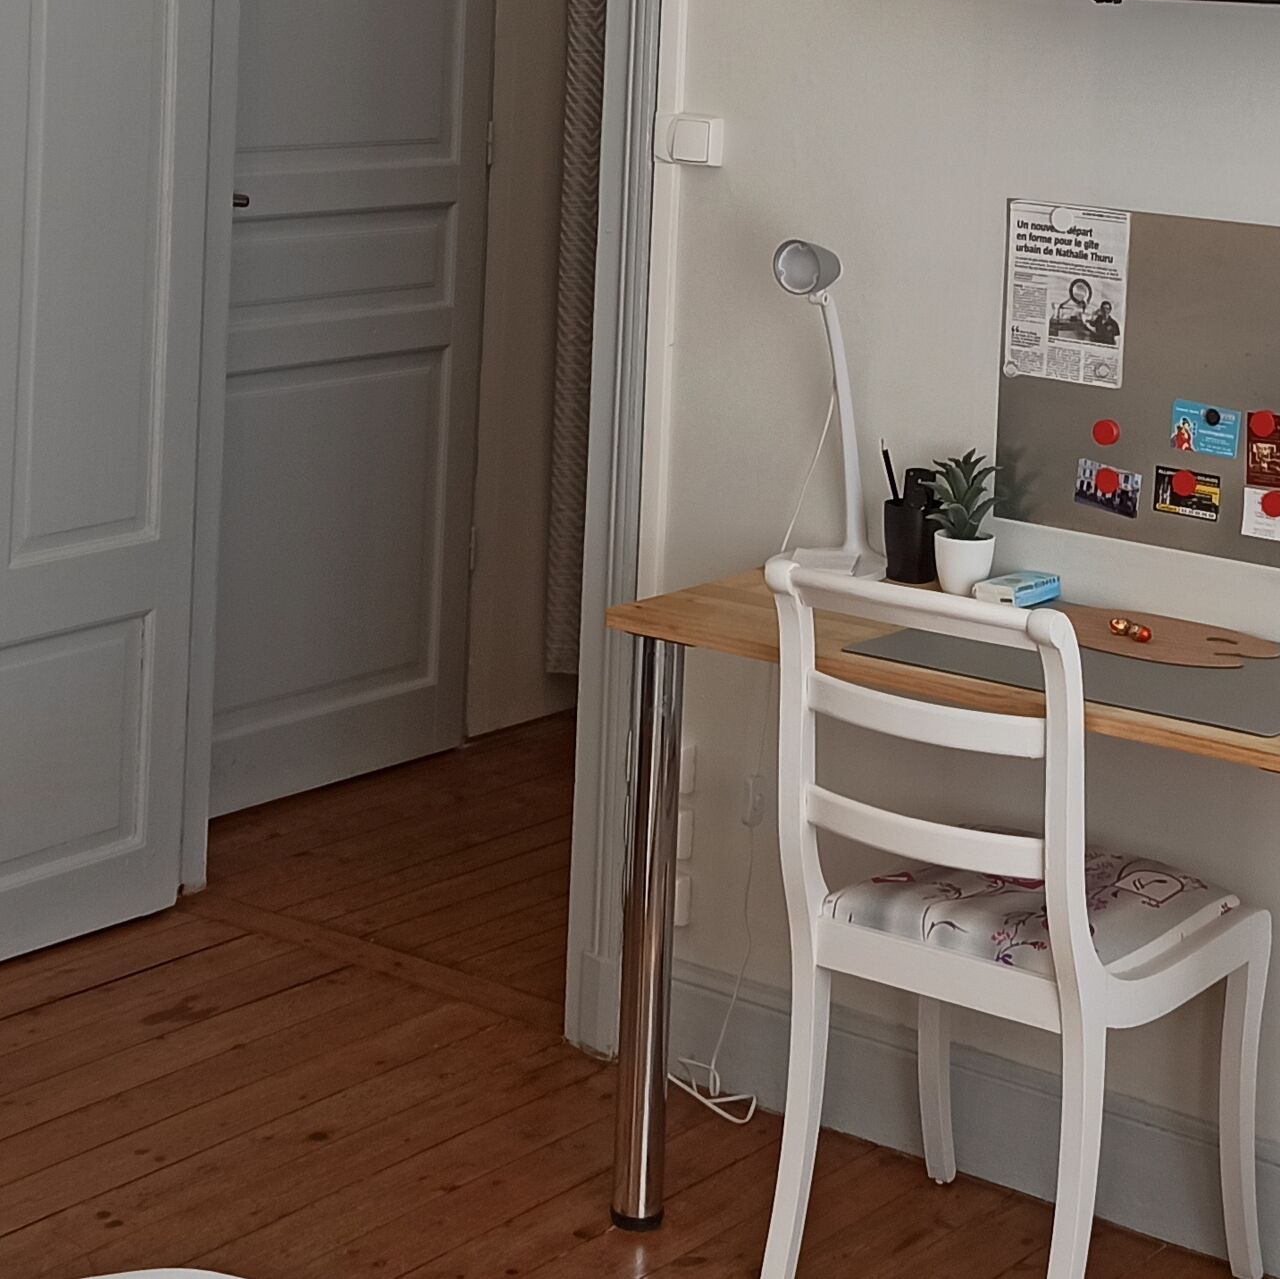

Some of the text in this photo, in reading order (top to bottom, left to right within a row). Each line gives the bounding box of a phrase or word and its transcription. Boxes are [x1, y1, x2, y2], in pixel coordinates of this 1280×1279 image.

[1017, 220, 1029, 230] Un
[1029, 231, 1052, 244] forme
[1054, 236, 1072, 247] pour
[1074, 237, 1082, 248] le
[1016, 243, 1041, 254] urbain
[1042, 245, 1054, 256] de
[1055, 247, 1089, 258] Nathalie
